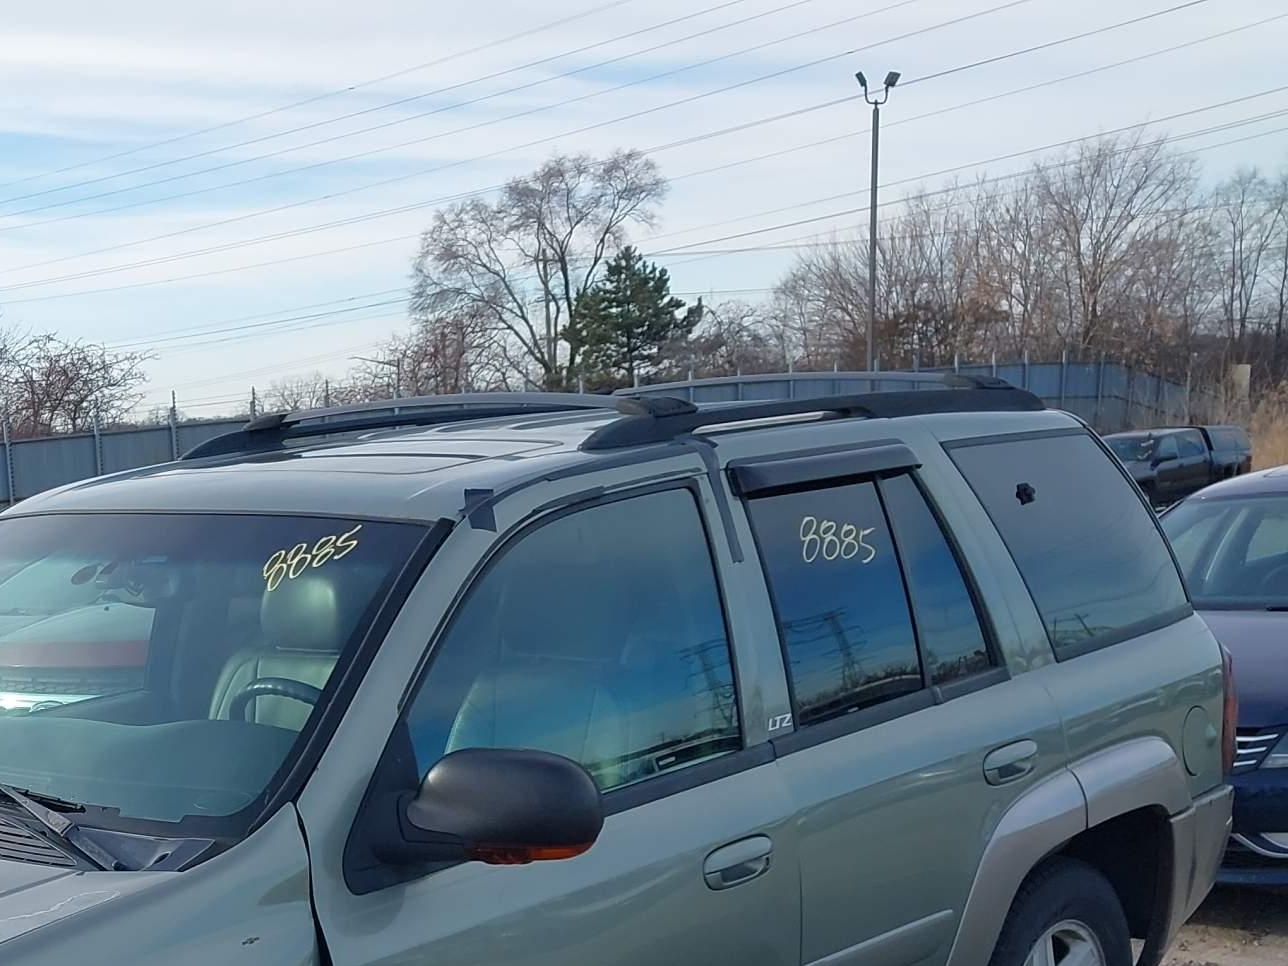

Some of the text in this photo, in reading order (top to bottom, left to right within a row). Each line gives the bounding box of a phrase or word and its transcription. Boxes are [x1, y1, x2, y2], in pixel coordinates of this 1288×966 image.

[263, 524, 363, 592] 8885
[799, 516, 876, 564] 8885
[768, 713, 793, 731] LTZ
